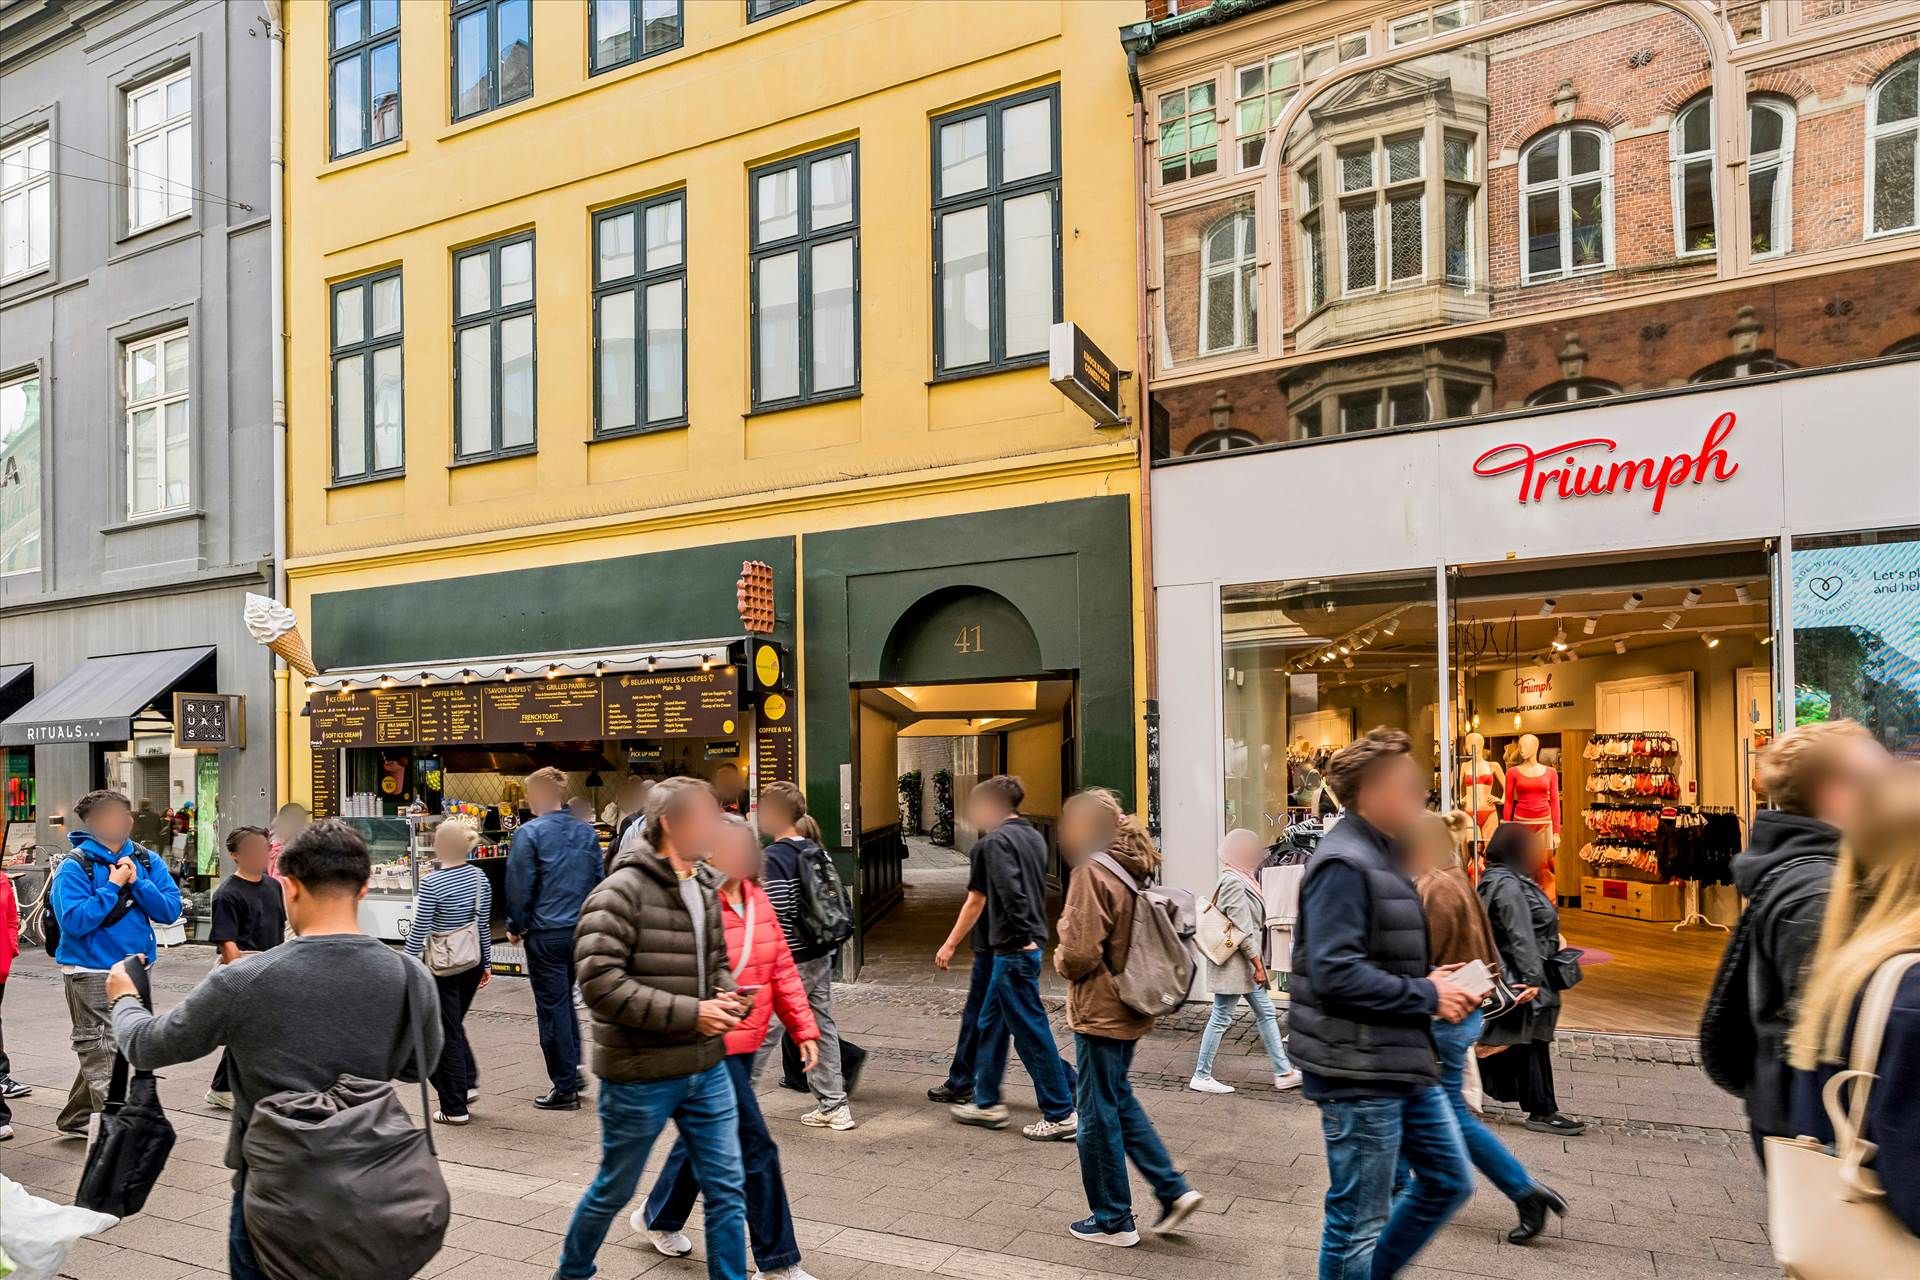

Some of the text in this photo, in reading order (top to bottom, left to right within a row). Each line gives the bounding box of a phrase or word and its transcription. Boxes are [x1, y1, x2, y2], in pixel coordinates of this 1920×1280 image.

[1473, 411, 1739, 514] Triumph
[1873, 582, 1897, 594] and
[953, 625, 985, 653] 41
[546, 683, 568, 691] GRILLED
[1513, 673, 1553, 698] Triumph
[336, 695, 352, 703] CREAM
[432, 690, 450, 698] COFFEE
[521, 712, 559, 721] FRENCH TOAST
[27, 725, 100, 740] RITUALS...
